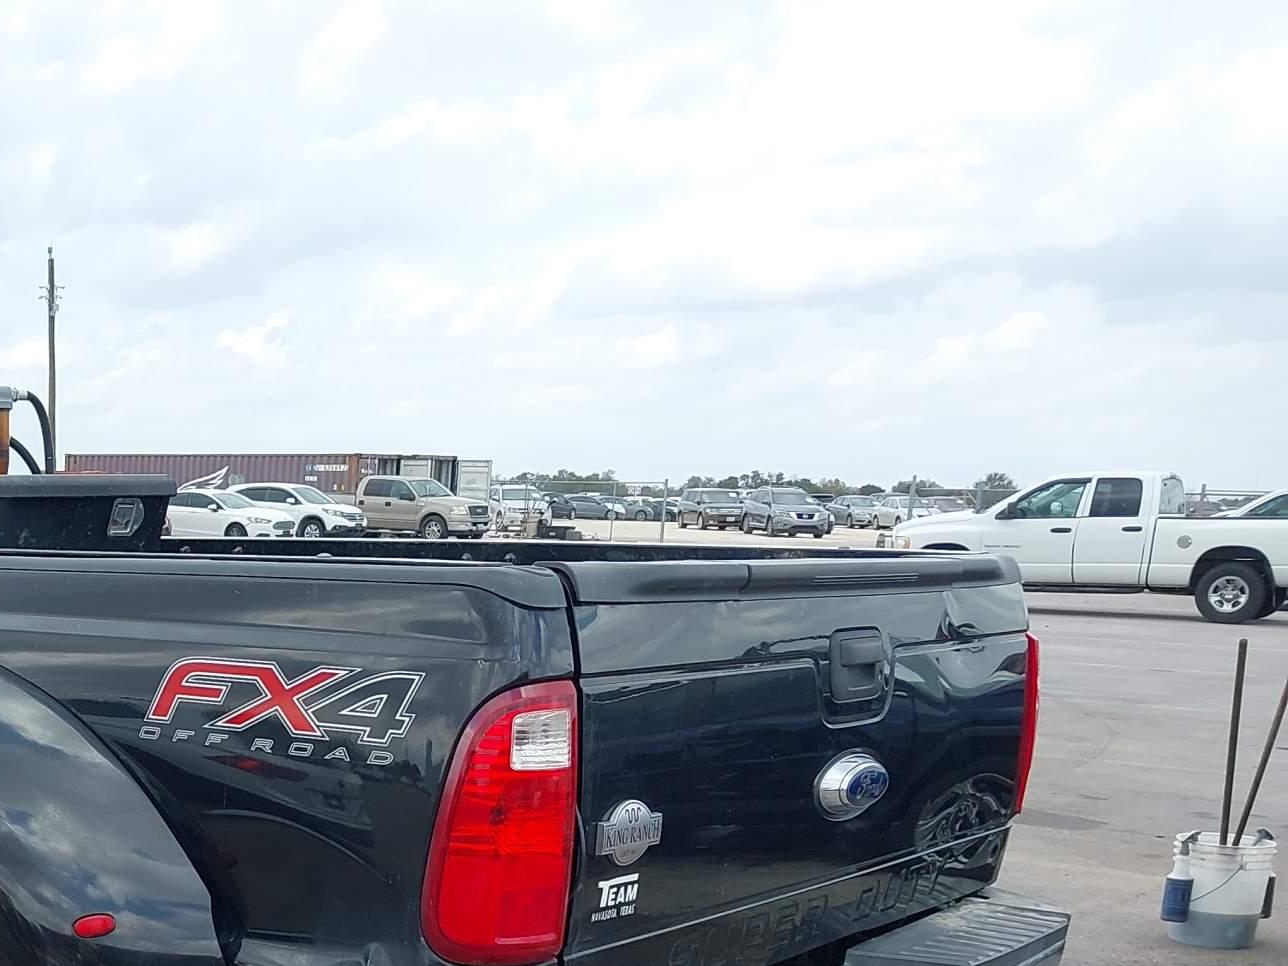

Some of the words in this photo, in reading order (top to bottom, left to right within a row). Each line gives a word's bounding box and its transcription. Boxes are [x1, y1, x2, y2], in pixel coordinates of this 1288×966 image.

[144, 656, 426, 747] FX4
[138, 725, 230, 747] OFF
[250, 737, 395, 766] ROAD
[606, 827, 629, 848] KING
[631, 819, 661, 843] RANCH
[598, 873, 640, 909] TEAM
